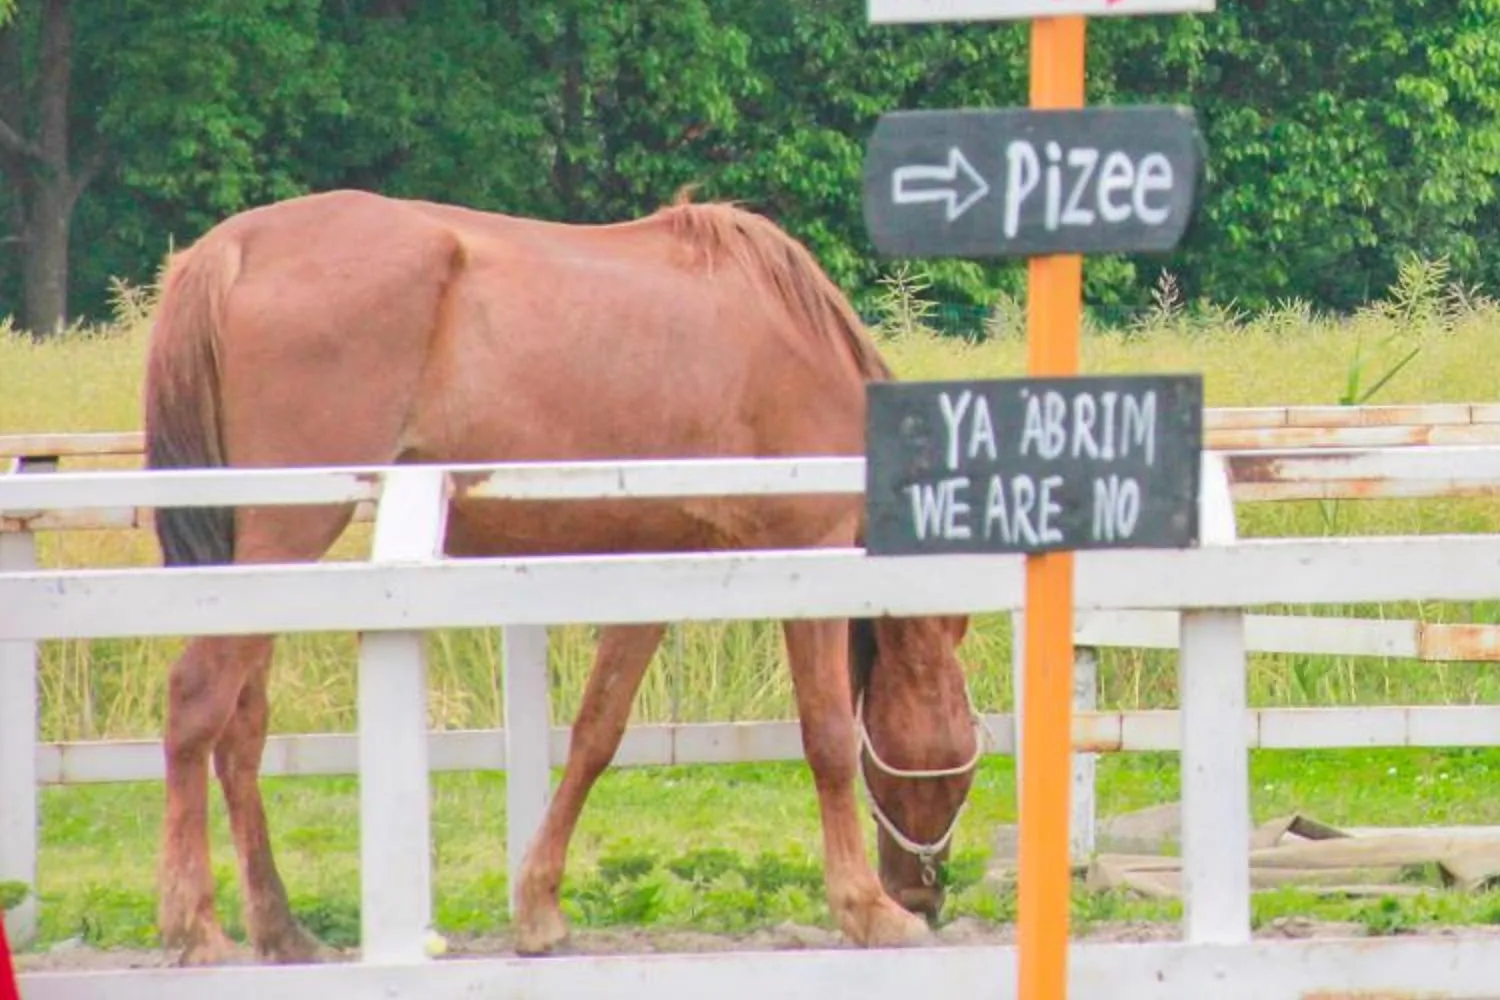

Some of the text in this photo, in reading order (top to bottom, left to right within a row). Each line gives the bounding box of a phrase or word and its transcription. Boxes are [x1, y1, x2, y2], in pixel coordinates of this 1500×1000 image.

[1003, 139, 1174, 238] Pizee
[939, 390, 998, 470] YA
[904, 474, 1141, 545] WE ARE NO
